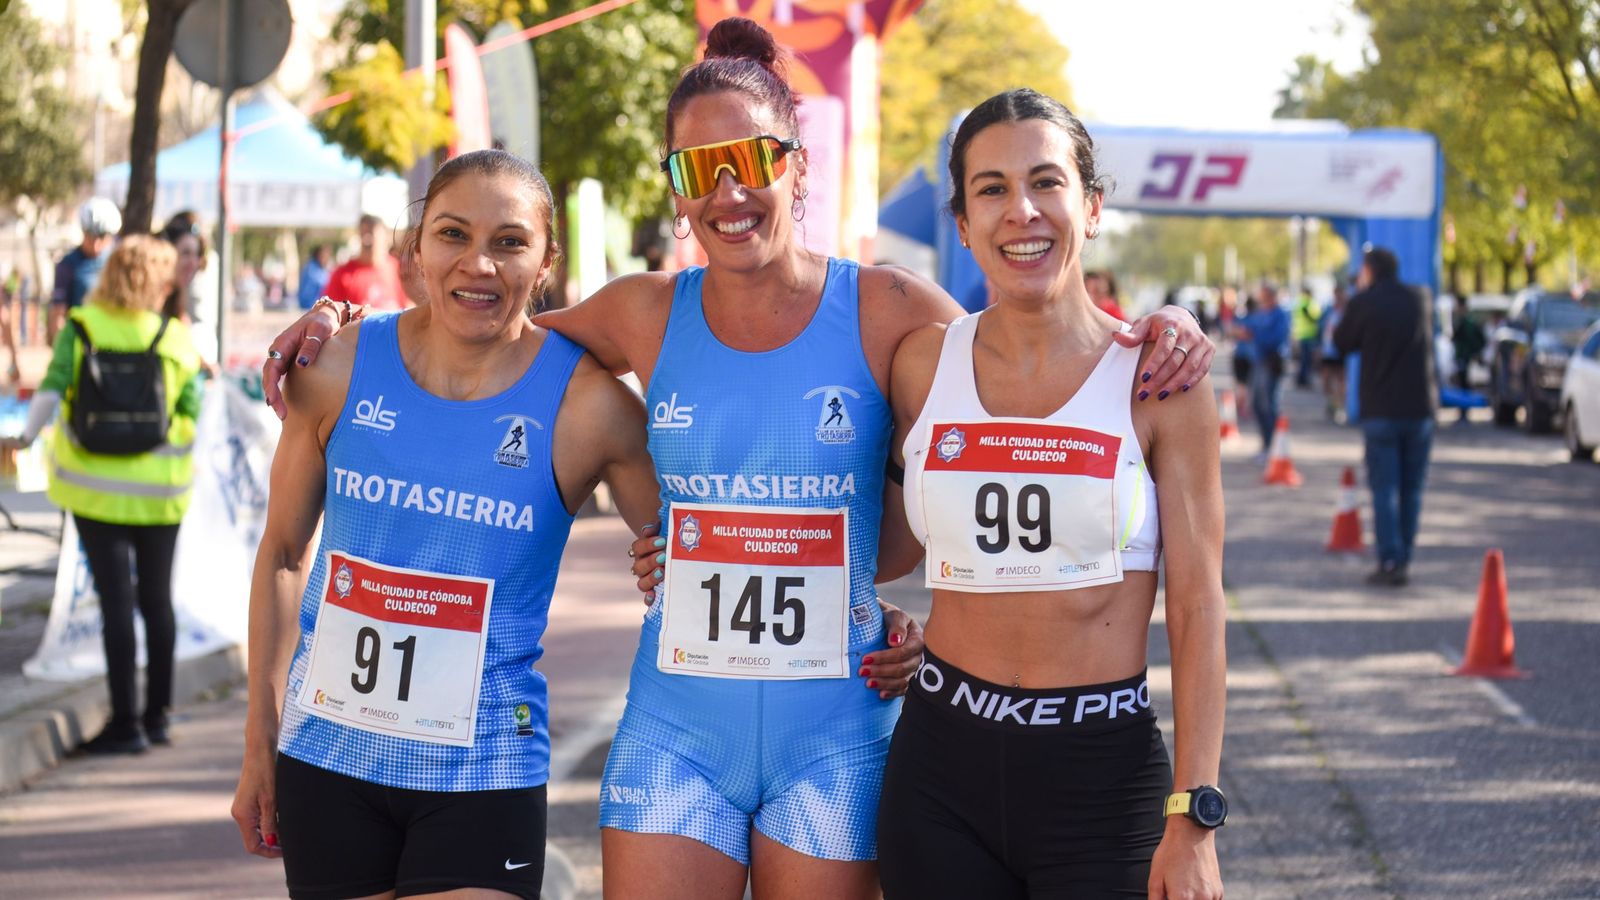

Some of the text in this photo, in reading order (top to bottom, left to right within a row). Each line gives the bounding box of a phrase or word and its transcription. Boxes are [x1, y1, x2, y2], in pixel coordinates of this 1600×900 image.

[352, 395, 397, 431] als
[652, 393, 694, 429] als
[979, 436, 1104, 456] MILLA CIUDAD DE CÓRDOBA
[1012, 451, 1067, 463] CULDECOR
[661, 472, 857, 499] TROTASIERRA
[333, 466, 535, 533] TROTASIERRA
[975, 482, 1052, 554] 99
[713, 526, 832, 539] MILLA CIUDAD DE CÓRDOBA
[745, 541, 798, 554] CULDECOR
[1006, 565, 1040, 575] IMDECO
[361, 579, 381, 593] MILLA
[382, 584, 414, 599] CIUDAD
[416, 591, 427, 600] DE
[430, 589, 472, 606] CÓRDOBA
[385, 599, 437, 616] CULDECOR
[701, 573, 805, 645] 145
[351, 626, 416, 702] 91
[737, 657, 771, 665] IMDECO
[950, 680, 1067, 726] NIKE
[368, 707, 399, 721] IMDECO
[622, 786, 646, 797] RUN
[624, 795, 649, 806] PRO
